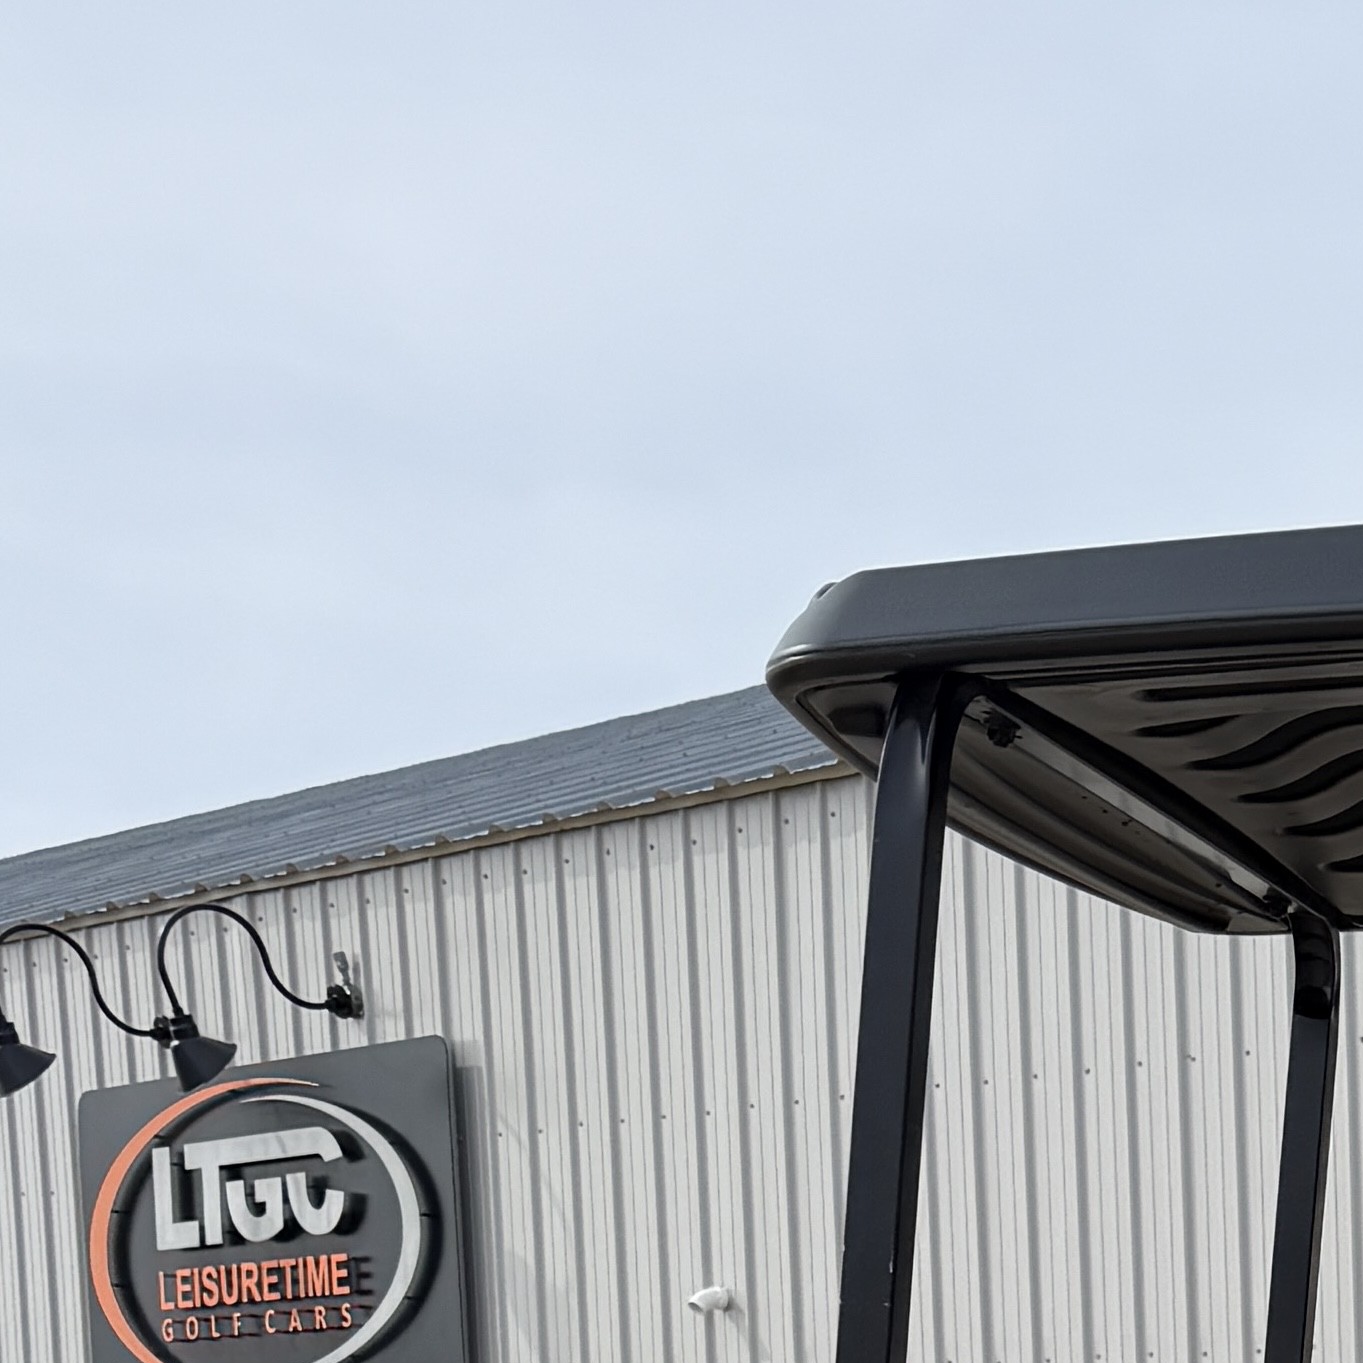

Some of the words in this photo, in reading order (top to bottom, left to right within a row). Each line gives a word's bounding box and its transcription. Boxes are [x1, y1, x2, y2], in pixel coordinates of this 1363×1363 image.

[152, 1126, 345, 1251] LTGC
[158, 1253, 351, 1311] LEISURETIME
[161, 1312, 242, 1343] GOLF
[264, 1302, 352, 1334] CARS
